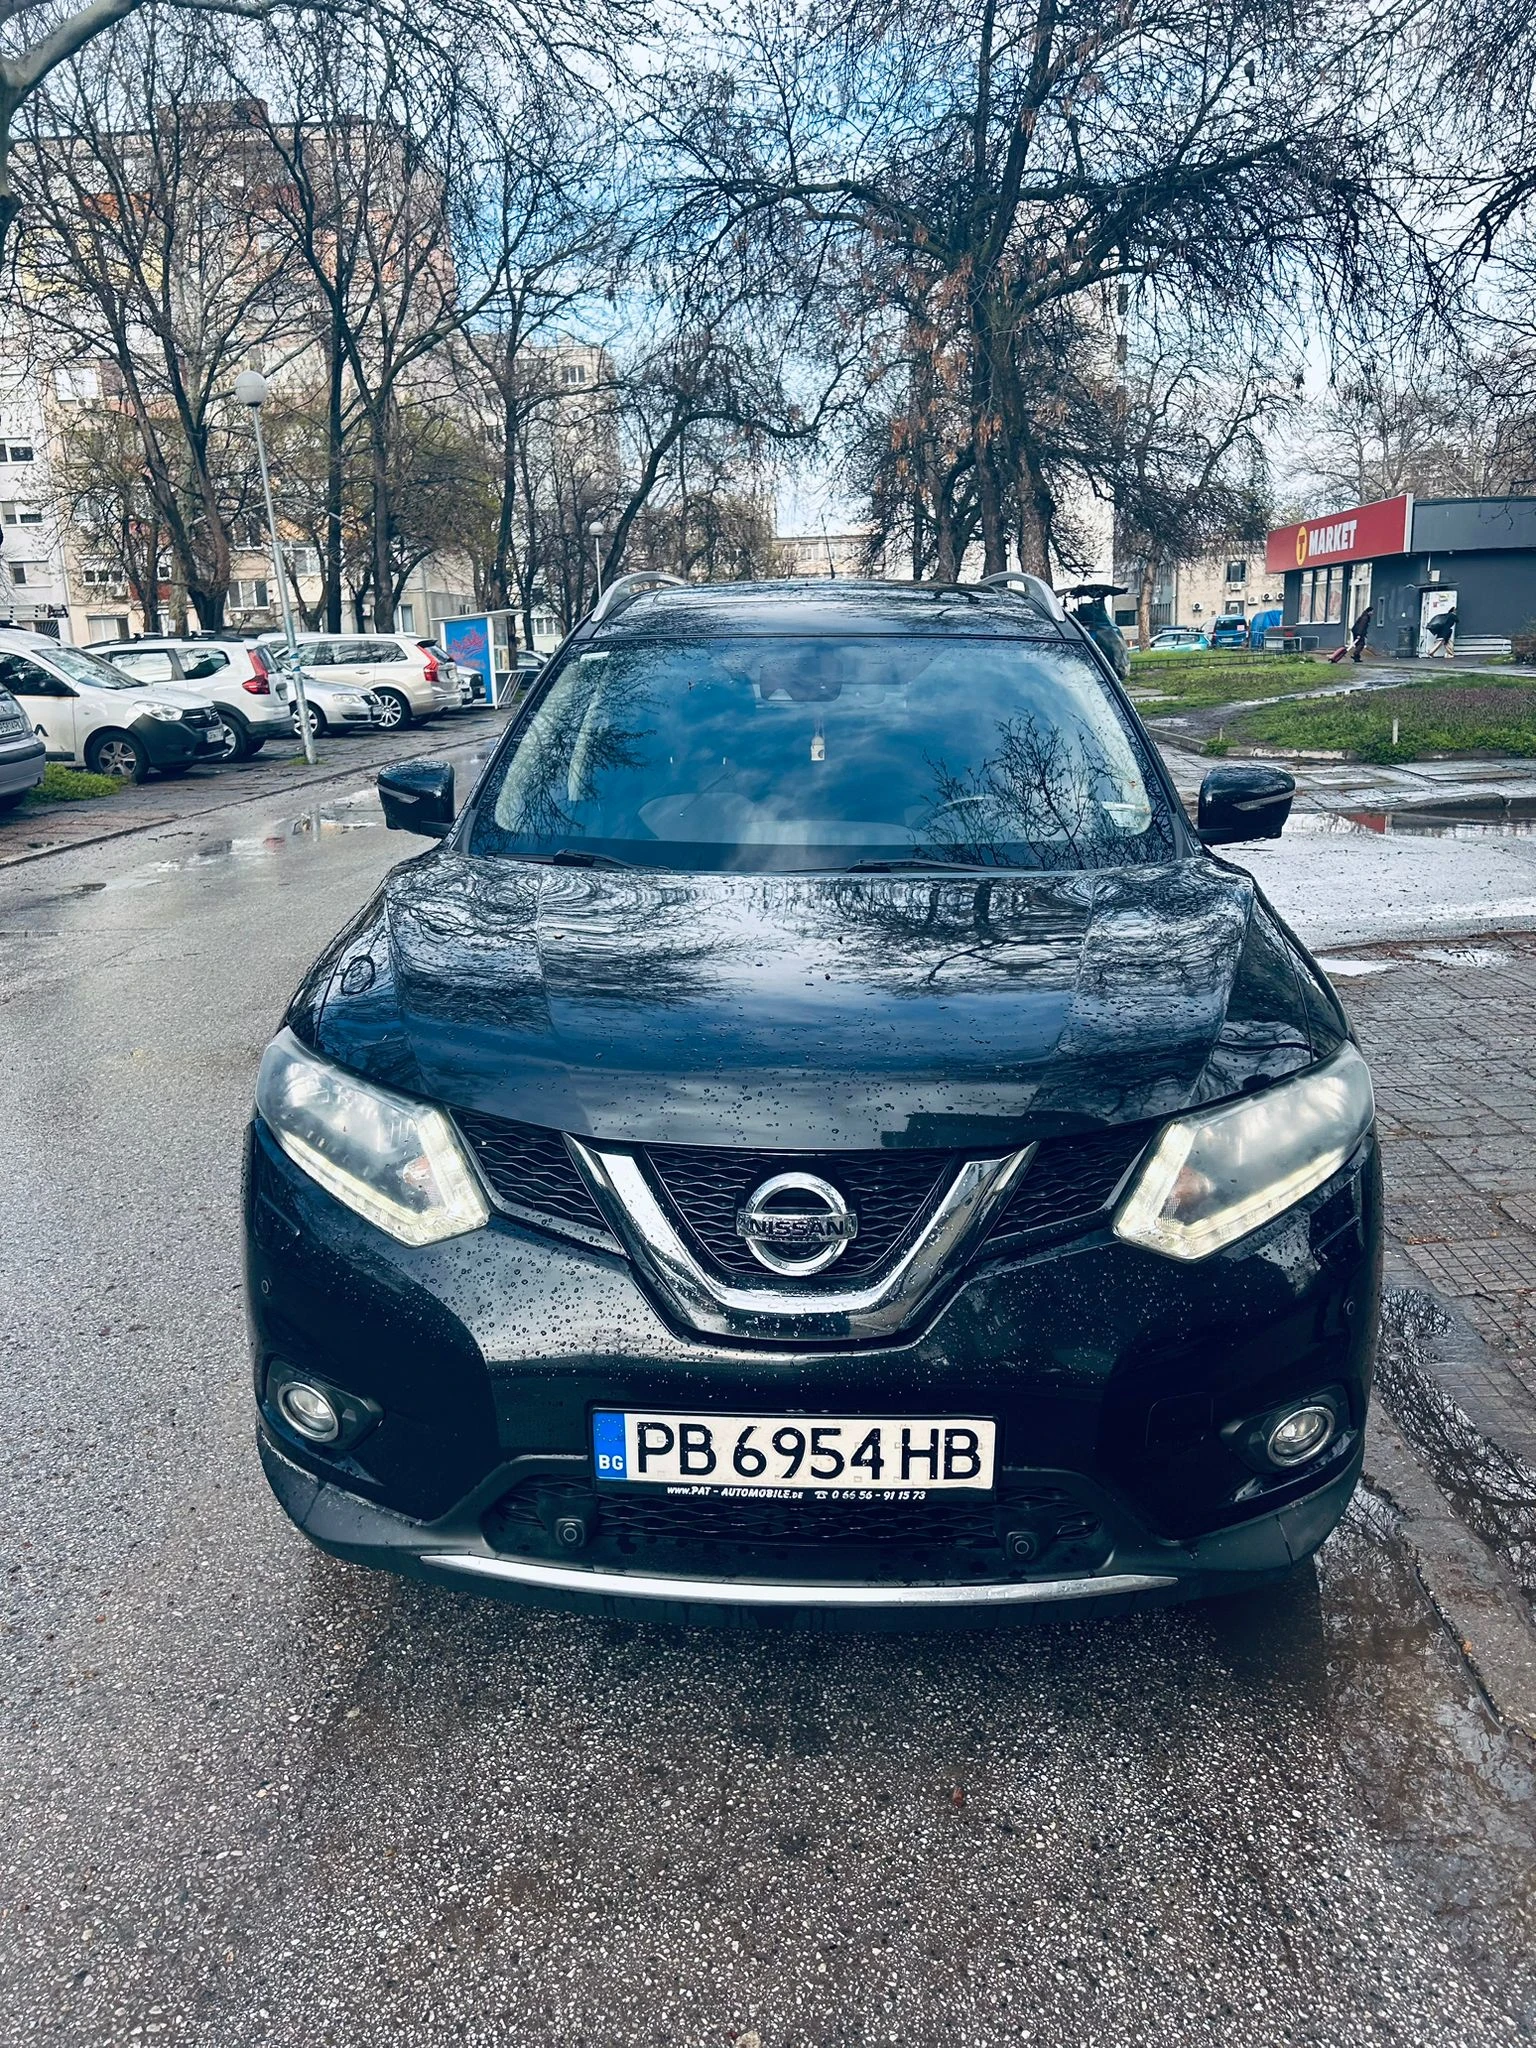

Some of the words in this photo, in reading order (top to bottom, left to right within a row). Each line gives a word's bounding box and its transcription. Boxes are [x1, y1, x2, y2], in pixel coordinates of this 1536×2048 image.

[1309, 519, 1357, 557] MARKET
[750, 1218, 844, 1237] NISSAN
[636, 1421, 717, 1476] PB
[733, 1425, 885, 1480] 6954
[900, 1428, 982, 1480] HB
[598, 1454, 625, 1471] BG
[912, 1490, 927, 1500] 73
